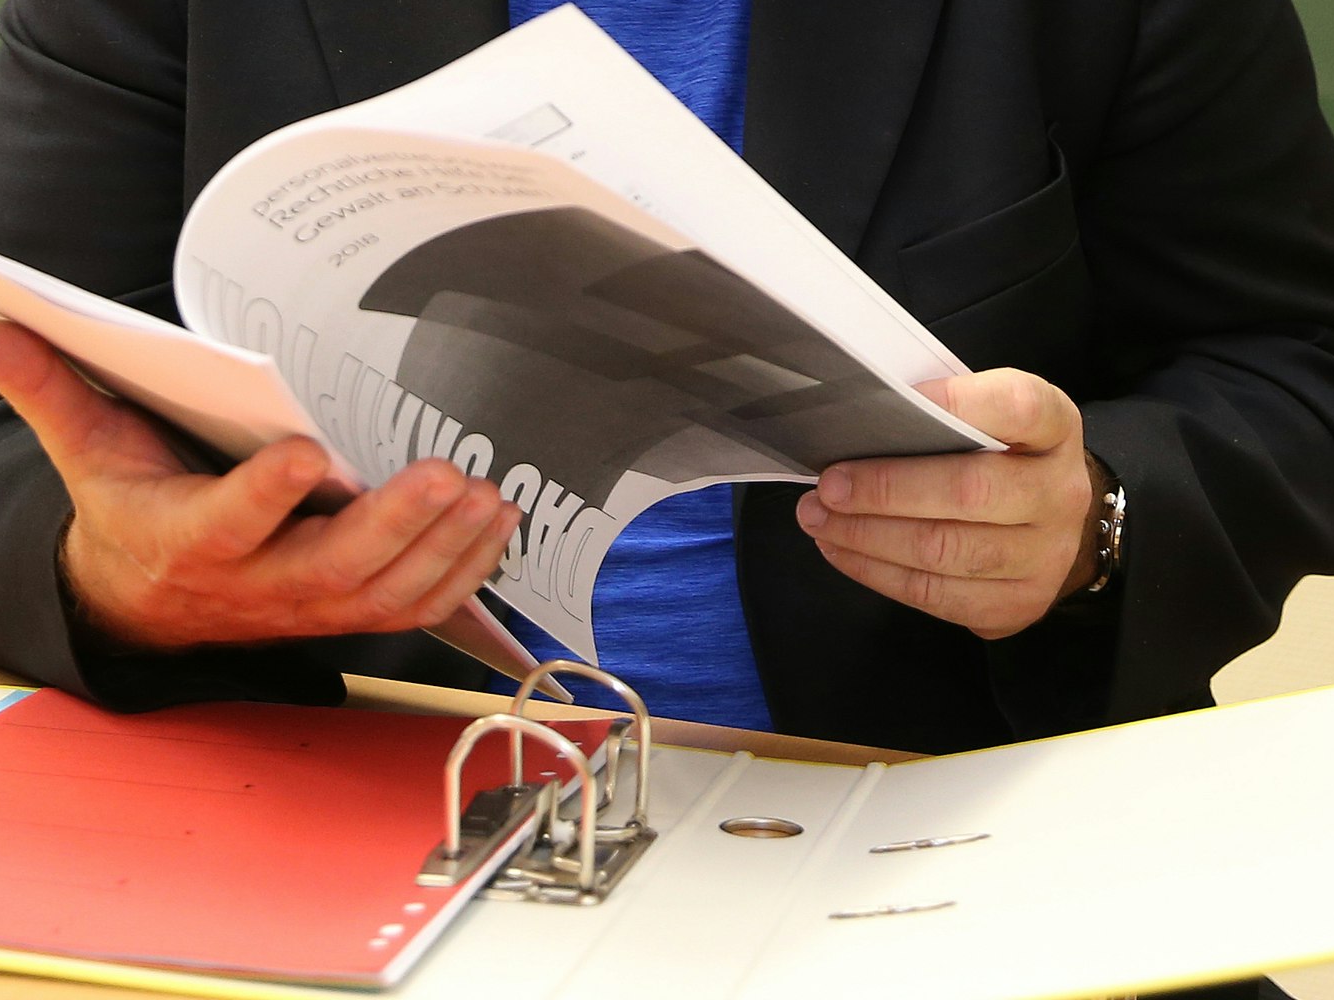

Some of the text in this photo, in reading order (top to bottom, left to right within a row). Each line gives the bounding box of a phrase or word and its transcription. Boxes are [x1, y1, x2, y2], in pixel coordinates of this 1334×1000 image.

[268, 165, 414, 230] Rechtliche
[294, 189, 391, 244] Gewalt
[398, 182, 434, 199] an
[328, 232, 380, 267] 2018
[498, 462, 616, 623] DAS
